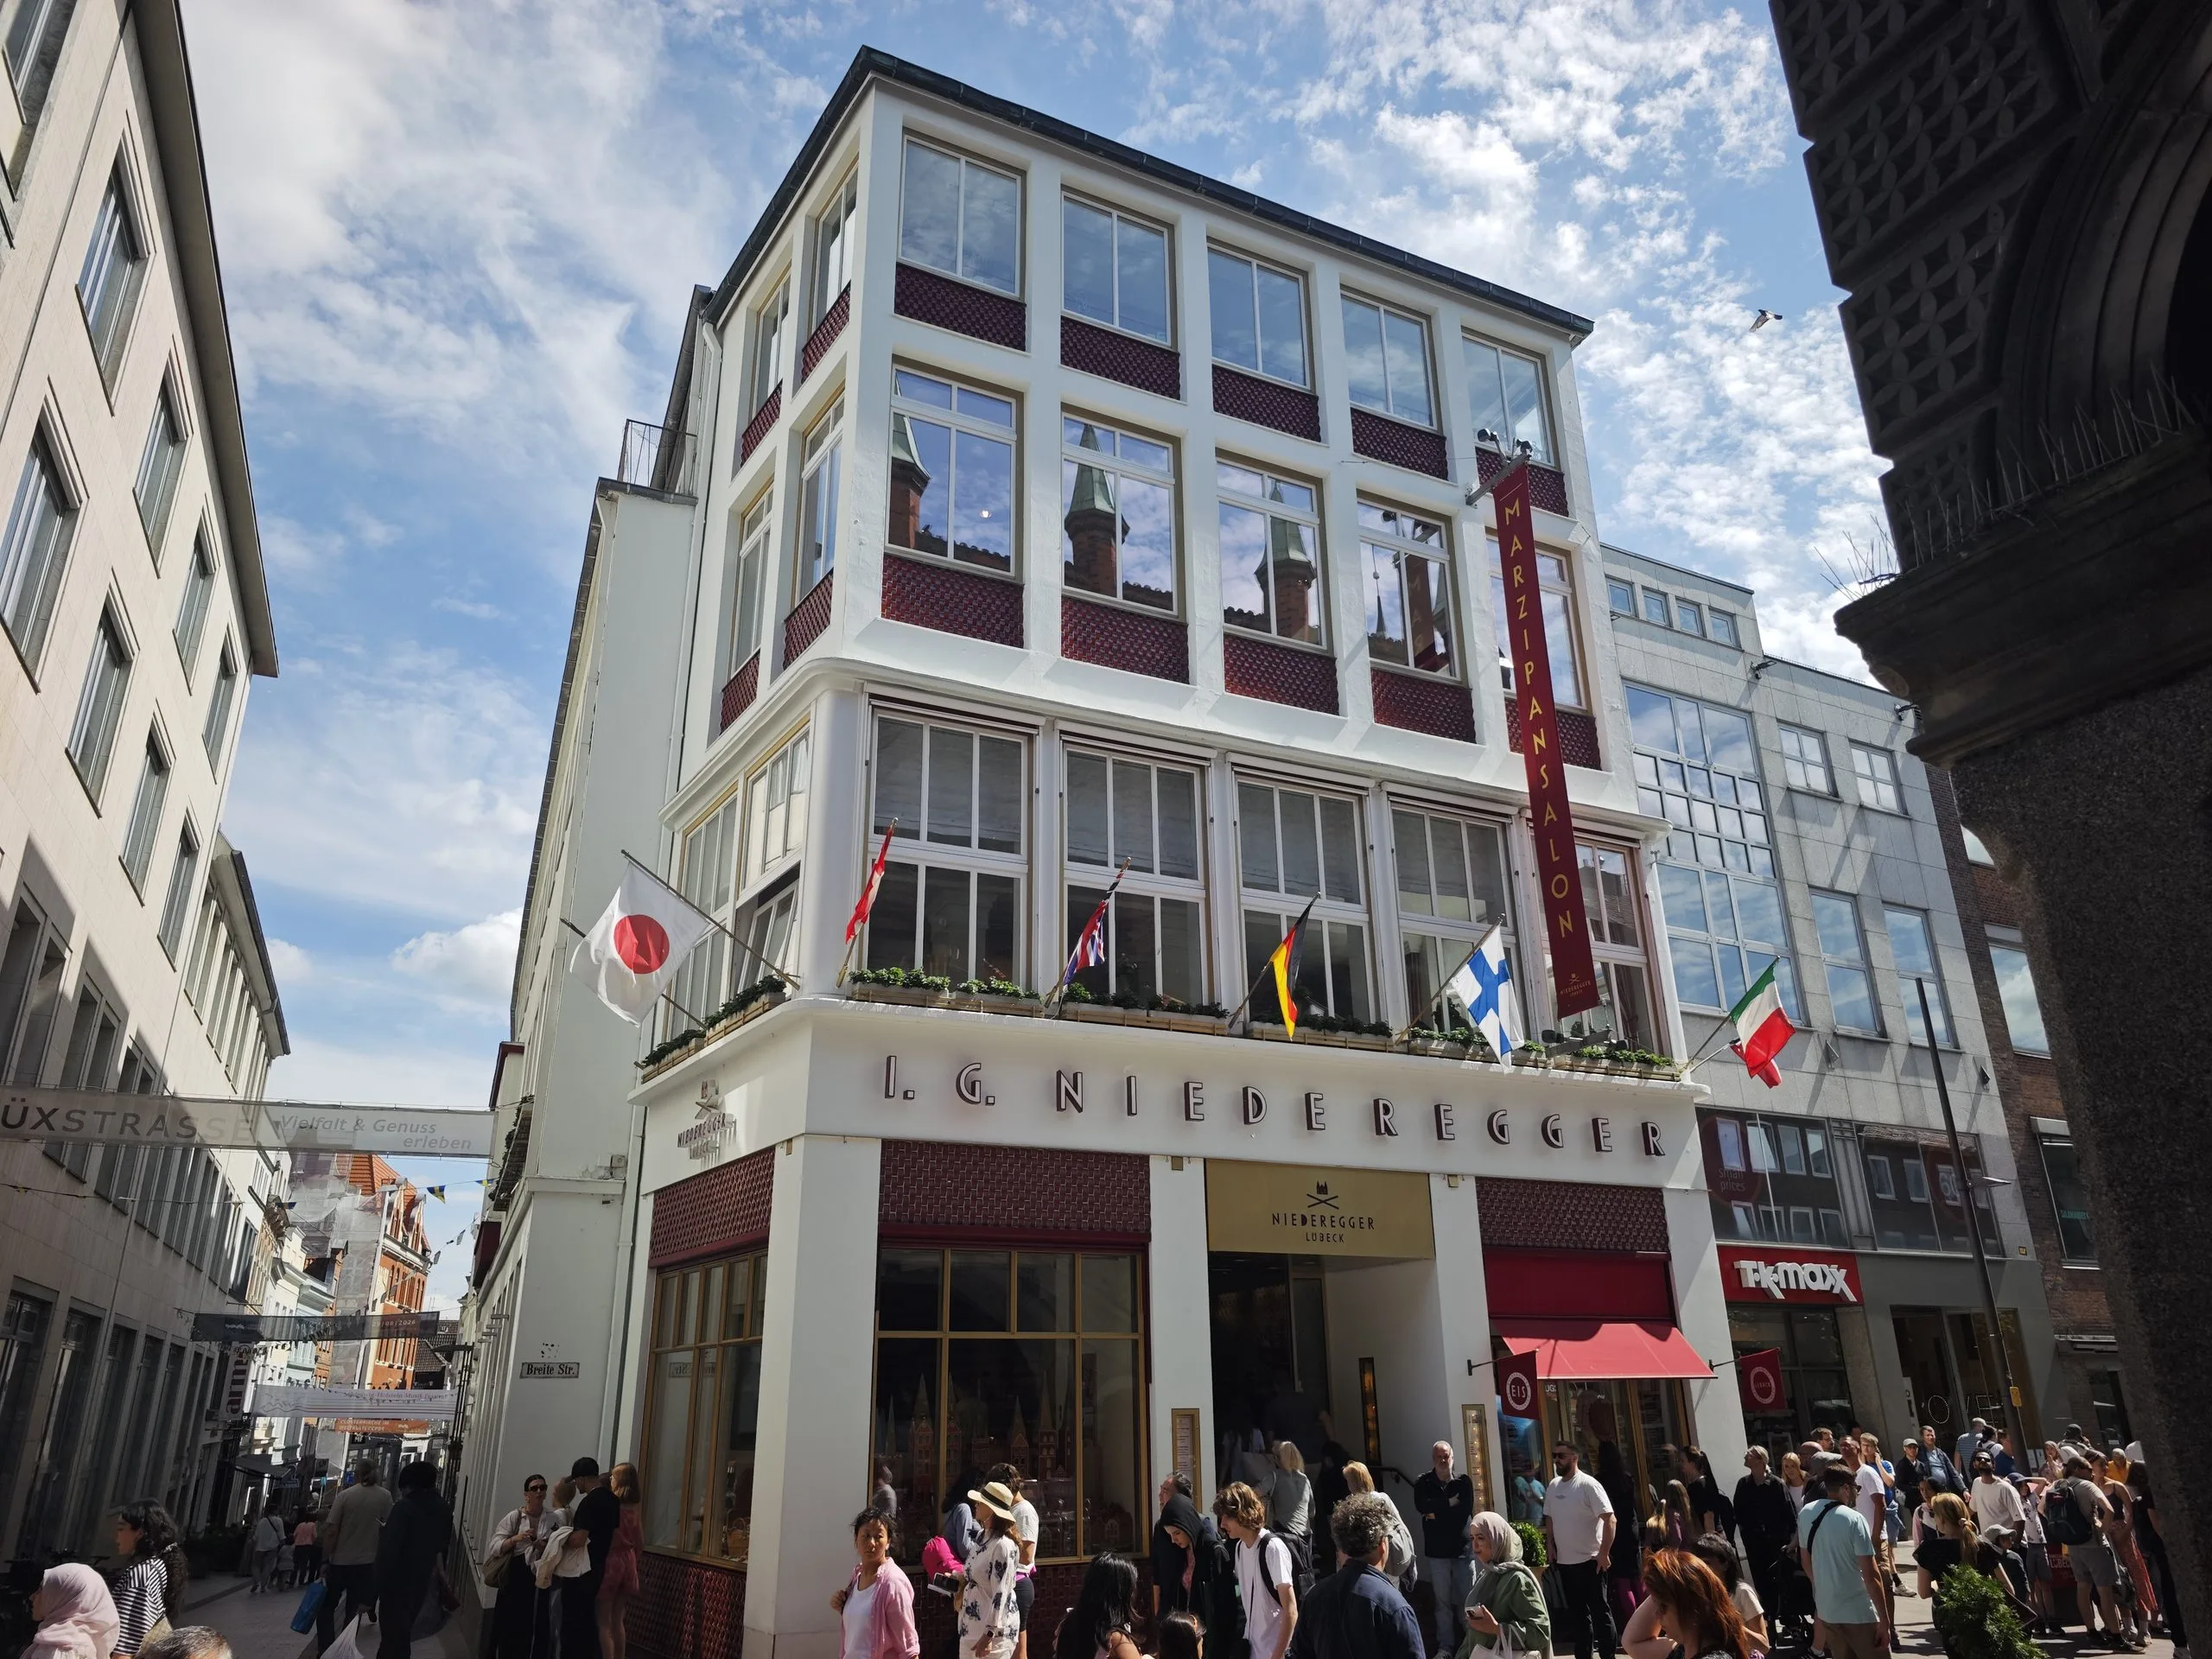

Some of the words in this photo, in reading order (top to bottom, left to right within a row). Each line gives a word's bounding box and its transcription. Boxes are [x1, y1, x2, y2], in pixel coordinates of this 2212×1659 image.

[1504, 497, 1573, 938] MARZIPANSALON
[956, 1062, 995, 1105] G.
[1056, 1069, 1666, 1157] NIEDEREGGER
[281, 1115, 348, 1131] Vielfalt
[353, 1117, 365, 1132] &
[372, 1118, 437, 1134] Genuss
[403, 1135, 472, 1150] erleben
[1719, 1179, 1745, 1192] prices
[1272, 1212, 1375, 1230] NIEDEREGGER
[526, 1363, 555, 1376] Breite
[558, 1363, 575, 1376] Str.
[1510, 1384, 1526, 1398] EIS
